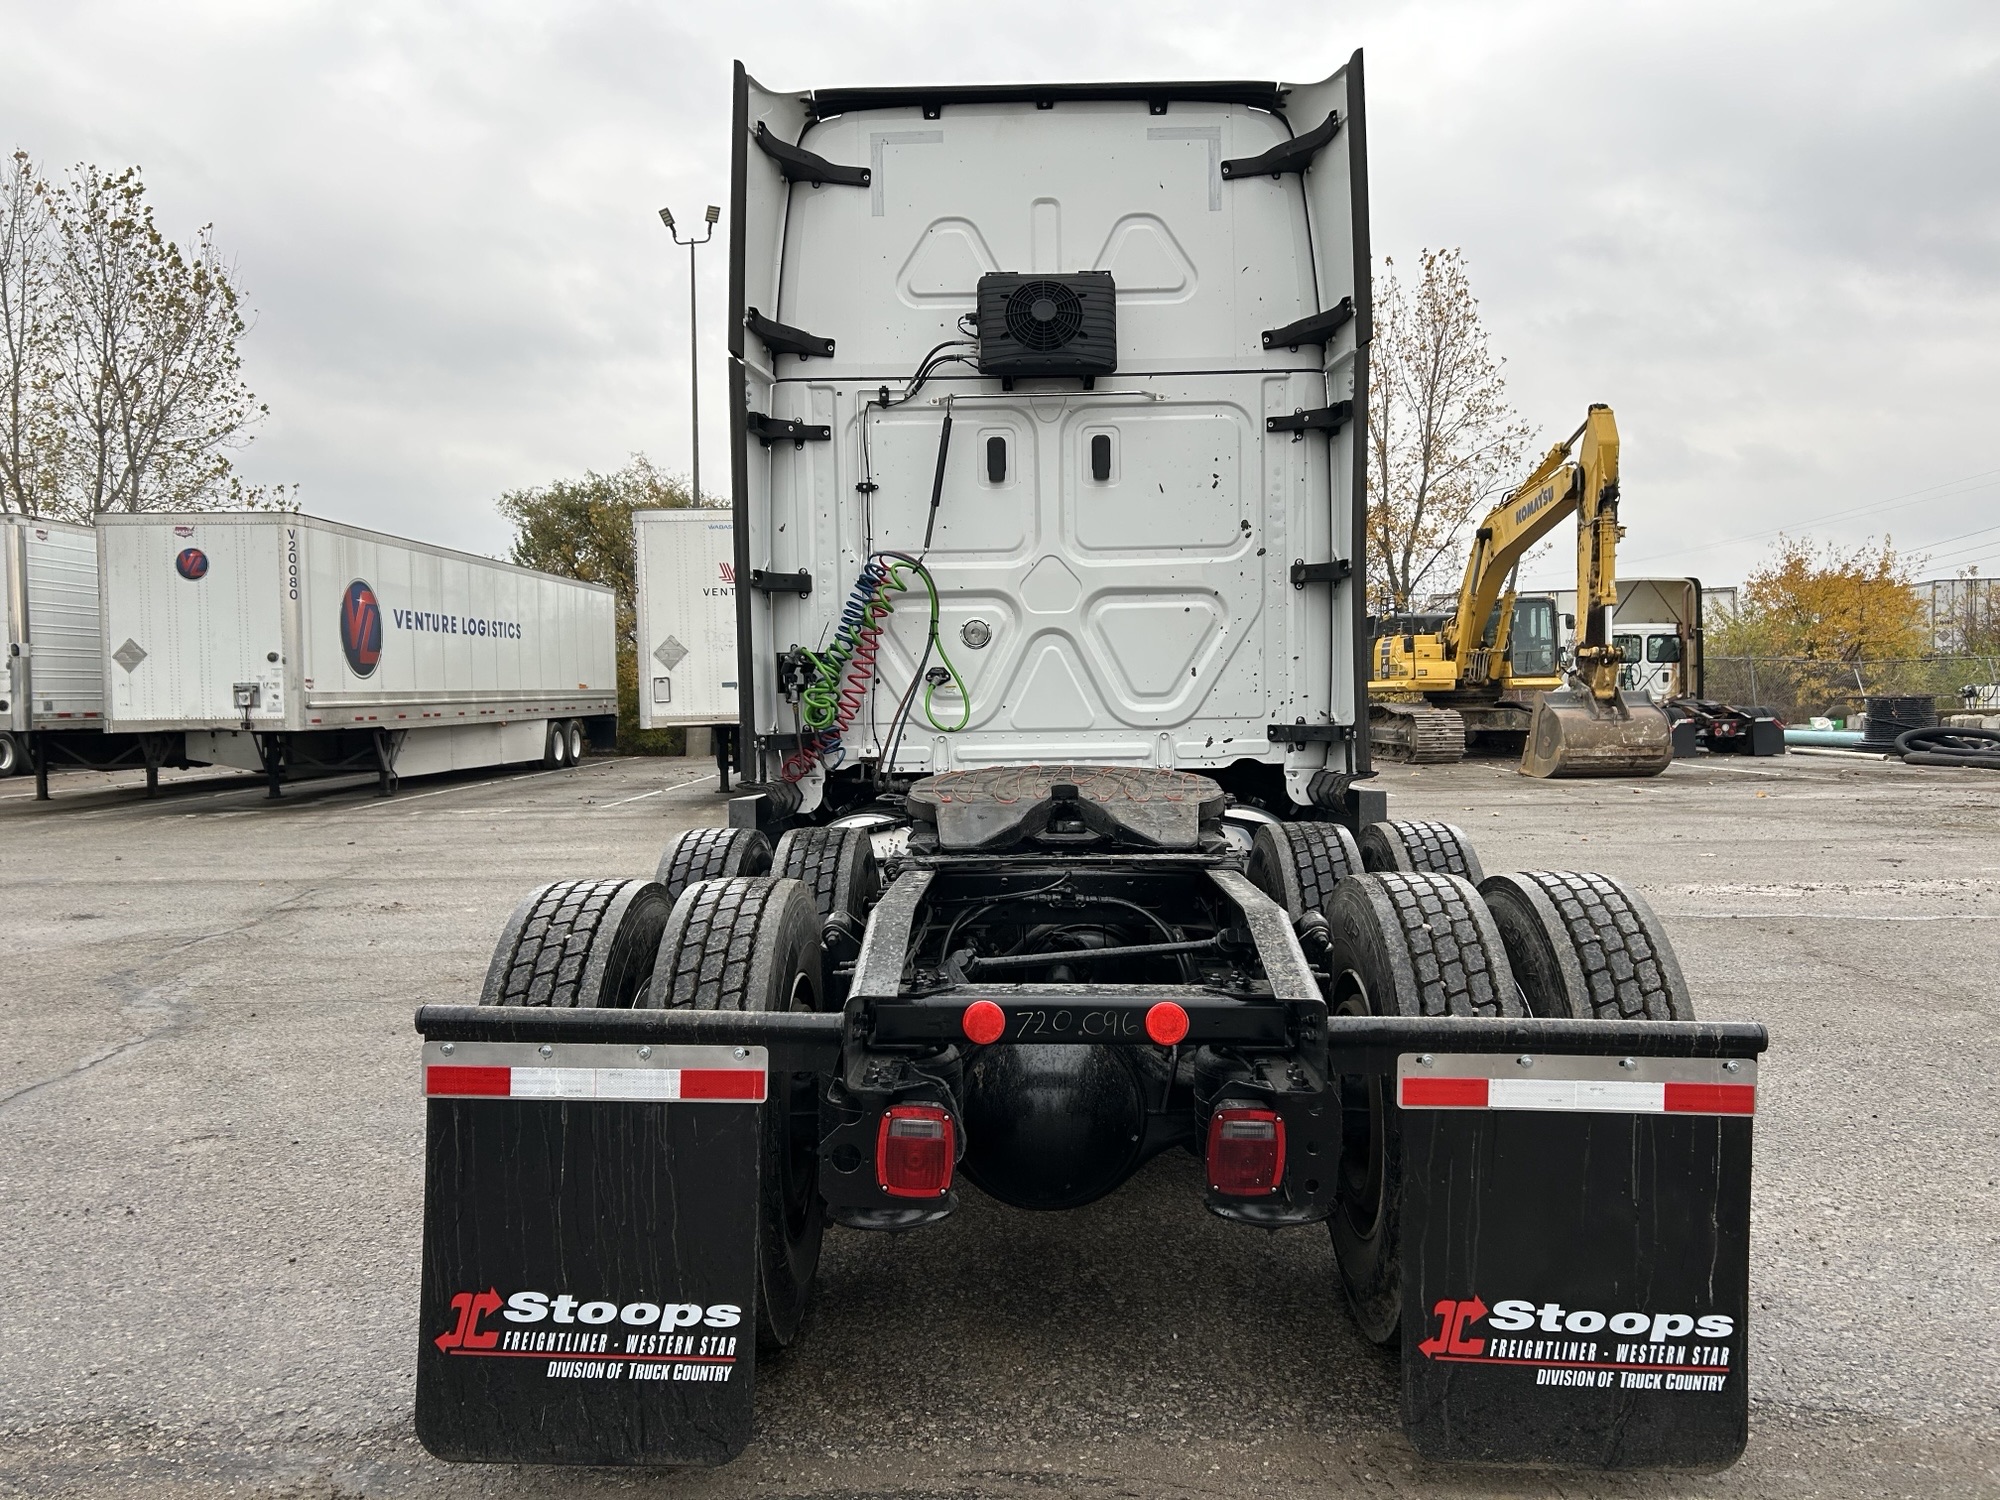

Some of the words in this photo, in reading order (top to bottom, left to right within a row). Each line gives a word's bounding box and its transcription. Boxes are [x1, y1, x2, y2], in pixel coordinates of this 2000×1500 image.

[1515, 485, 1554, 526] KOMATSU
[287, 529, 299, 600] V20080
[393, 608, 457, 634] VENTURE
[462, 617, 522, 640] LOGISTICS
[502, 1291, 742, 1333] Stoops
[1488, 1299, 1735, 1343] Stoops
[502, 1330, 608, 1353] FREIGHTLINER
[625, 1333, 694, 1355] WESTERN
[699, 1336, 737, 1356] STAR
[1489, 1338, 1598, 1362] FREIGHTLINER
[1615, 1343, 1686, 1365] WESTERN
[1691, 1346, 1730, 1366] STAR
[546, 1361, 606, 1379] DIVISION
[606, 1362, 624, 1379] OF
[628, 1362, 671, 1380] TRUCK
[673, 1363, 733, 1382] COUNTRY
[1536, 1368, 1596, 1387] DIVISION
[1597, 1371, 1615, 1388] OF
[1620, 1371, 1662, 1390] TRUCK
[1665, 1373, 1727, 1392] COUNTRY
